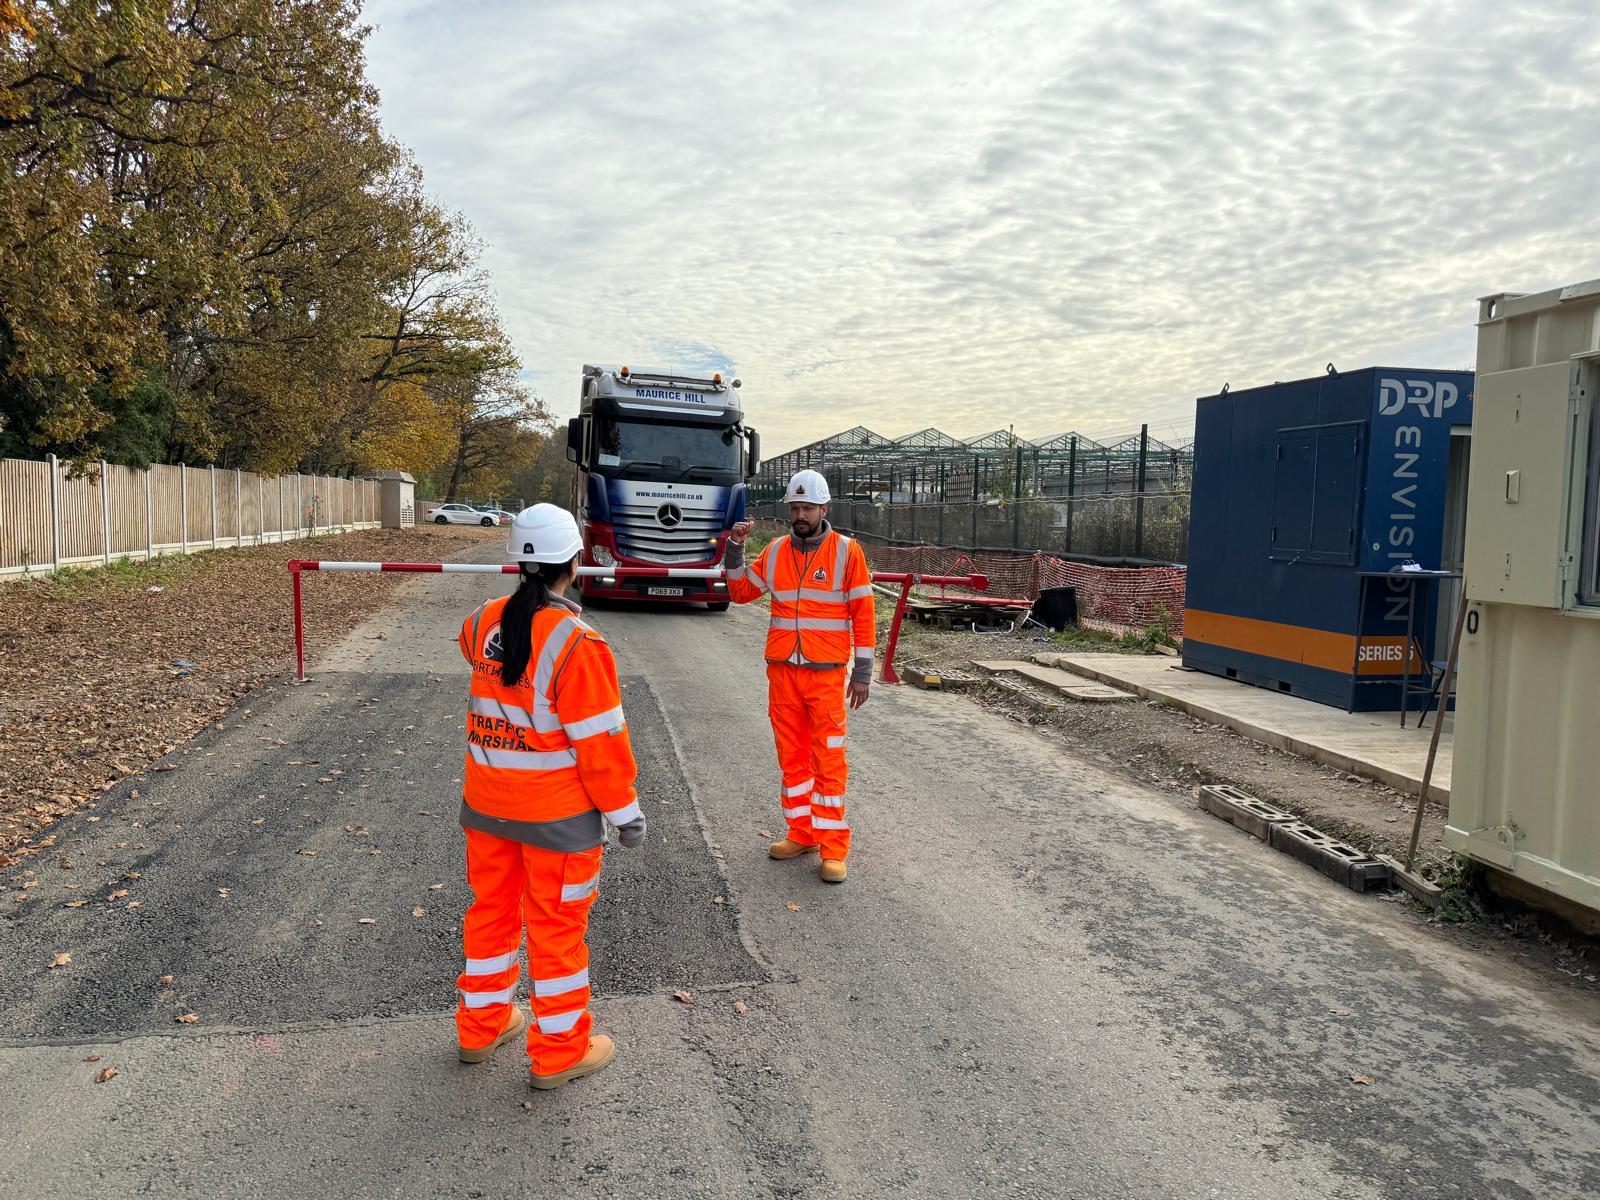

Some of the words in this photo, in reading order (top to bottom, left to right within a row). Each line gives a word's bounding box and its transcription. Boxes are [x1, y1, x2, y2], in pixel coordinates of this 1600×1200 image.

[635, 389, 681, 401] MAURICE
[684, 393, 706, 404] HILL
[1379, 378, 1458, 418] DRP
[635, 490, 703, 501] www.mauricehill.co.uk
[1358, 645, 1403, 661] SERIES
